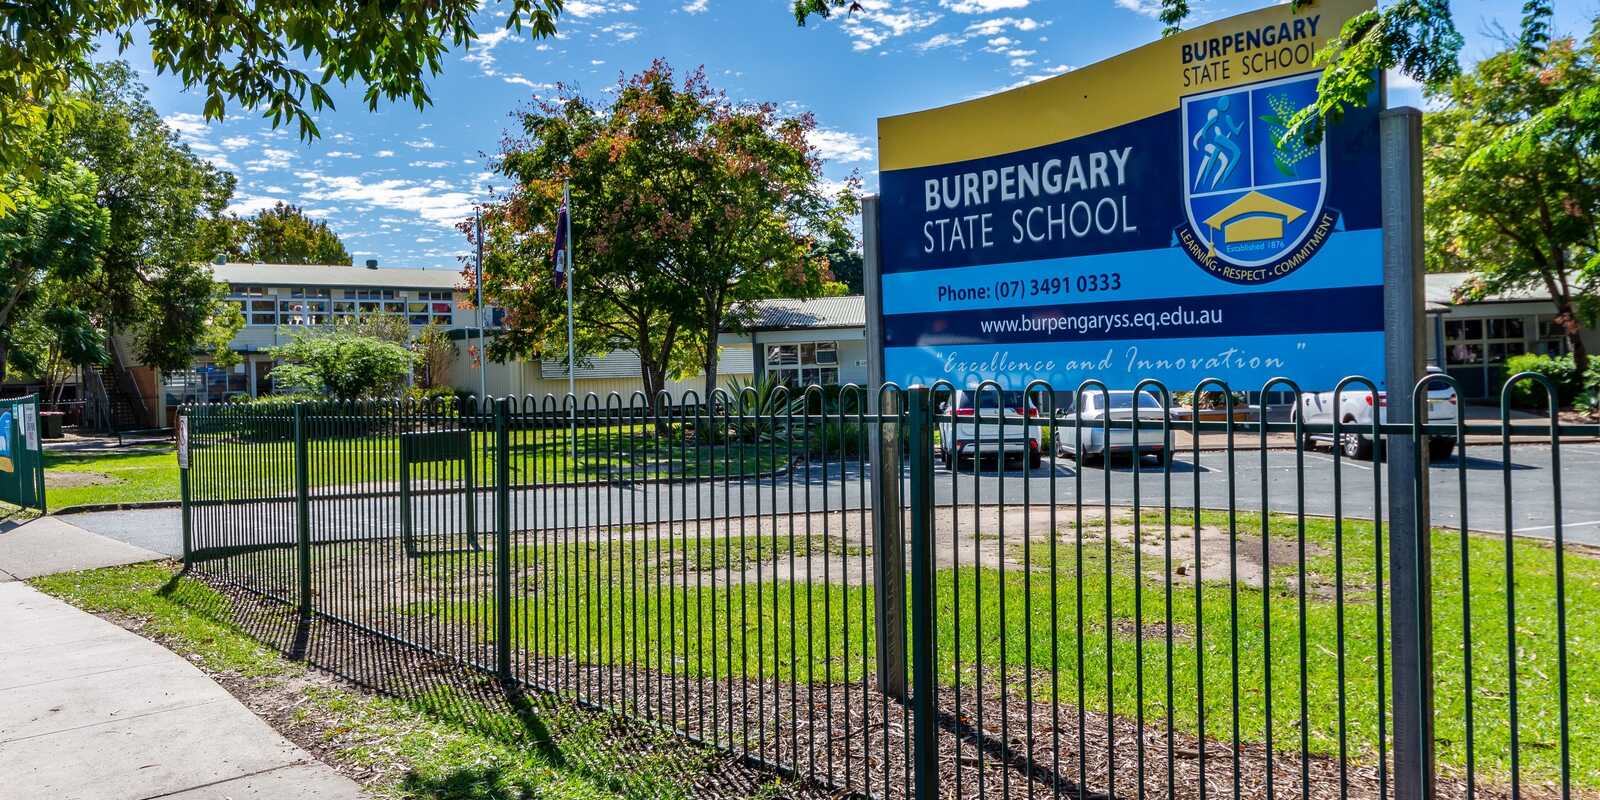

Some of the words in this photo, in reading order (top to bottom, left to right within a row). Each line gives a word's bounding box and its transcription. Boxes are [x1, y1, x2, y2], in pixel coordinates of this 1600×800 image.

[1182, 15, 1320, 64] BURPENGARY
[1183, 60, 1230, 87] STATE
[925, 147, 1133, 212] BURPENGARY
[924, 213, 994, 253] STATE
[1012, 195, 1137, 244] SCHOOL
[1180, 228, 1217, 271] LEARNING
[1223, 266, 1267, 281] RESPECT
[1274, 213, 1334, 276] COMMITMENT
[1226, 241, 1265, 253] Established
[938, 285, 991, 302] Phone:
[994, 280, 1025, 301] (07)
[1030, 276, 1071, 296] 3491
[1076, 273, 1121, 293] 0333
[980, 305, 1223, 334] www.burpengaryss.eq.edu.au
[1065, 349, 1113, 371] and
